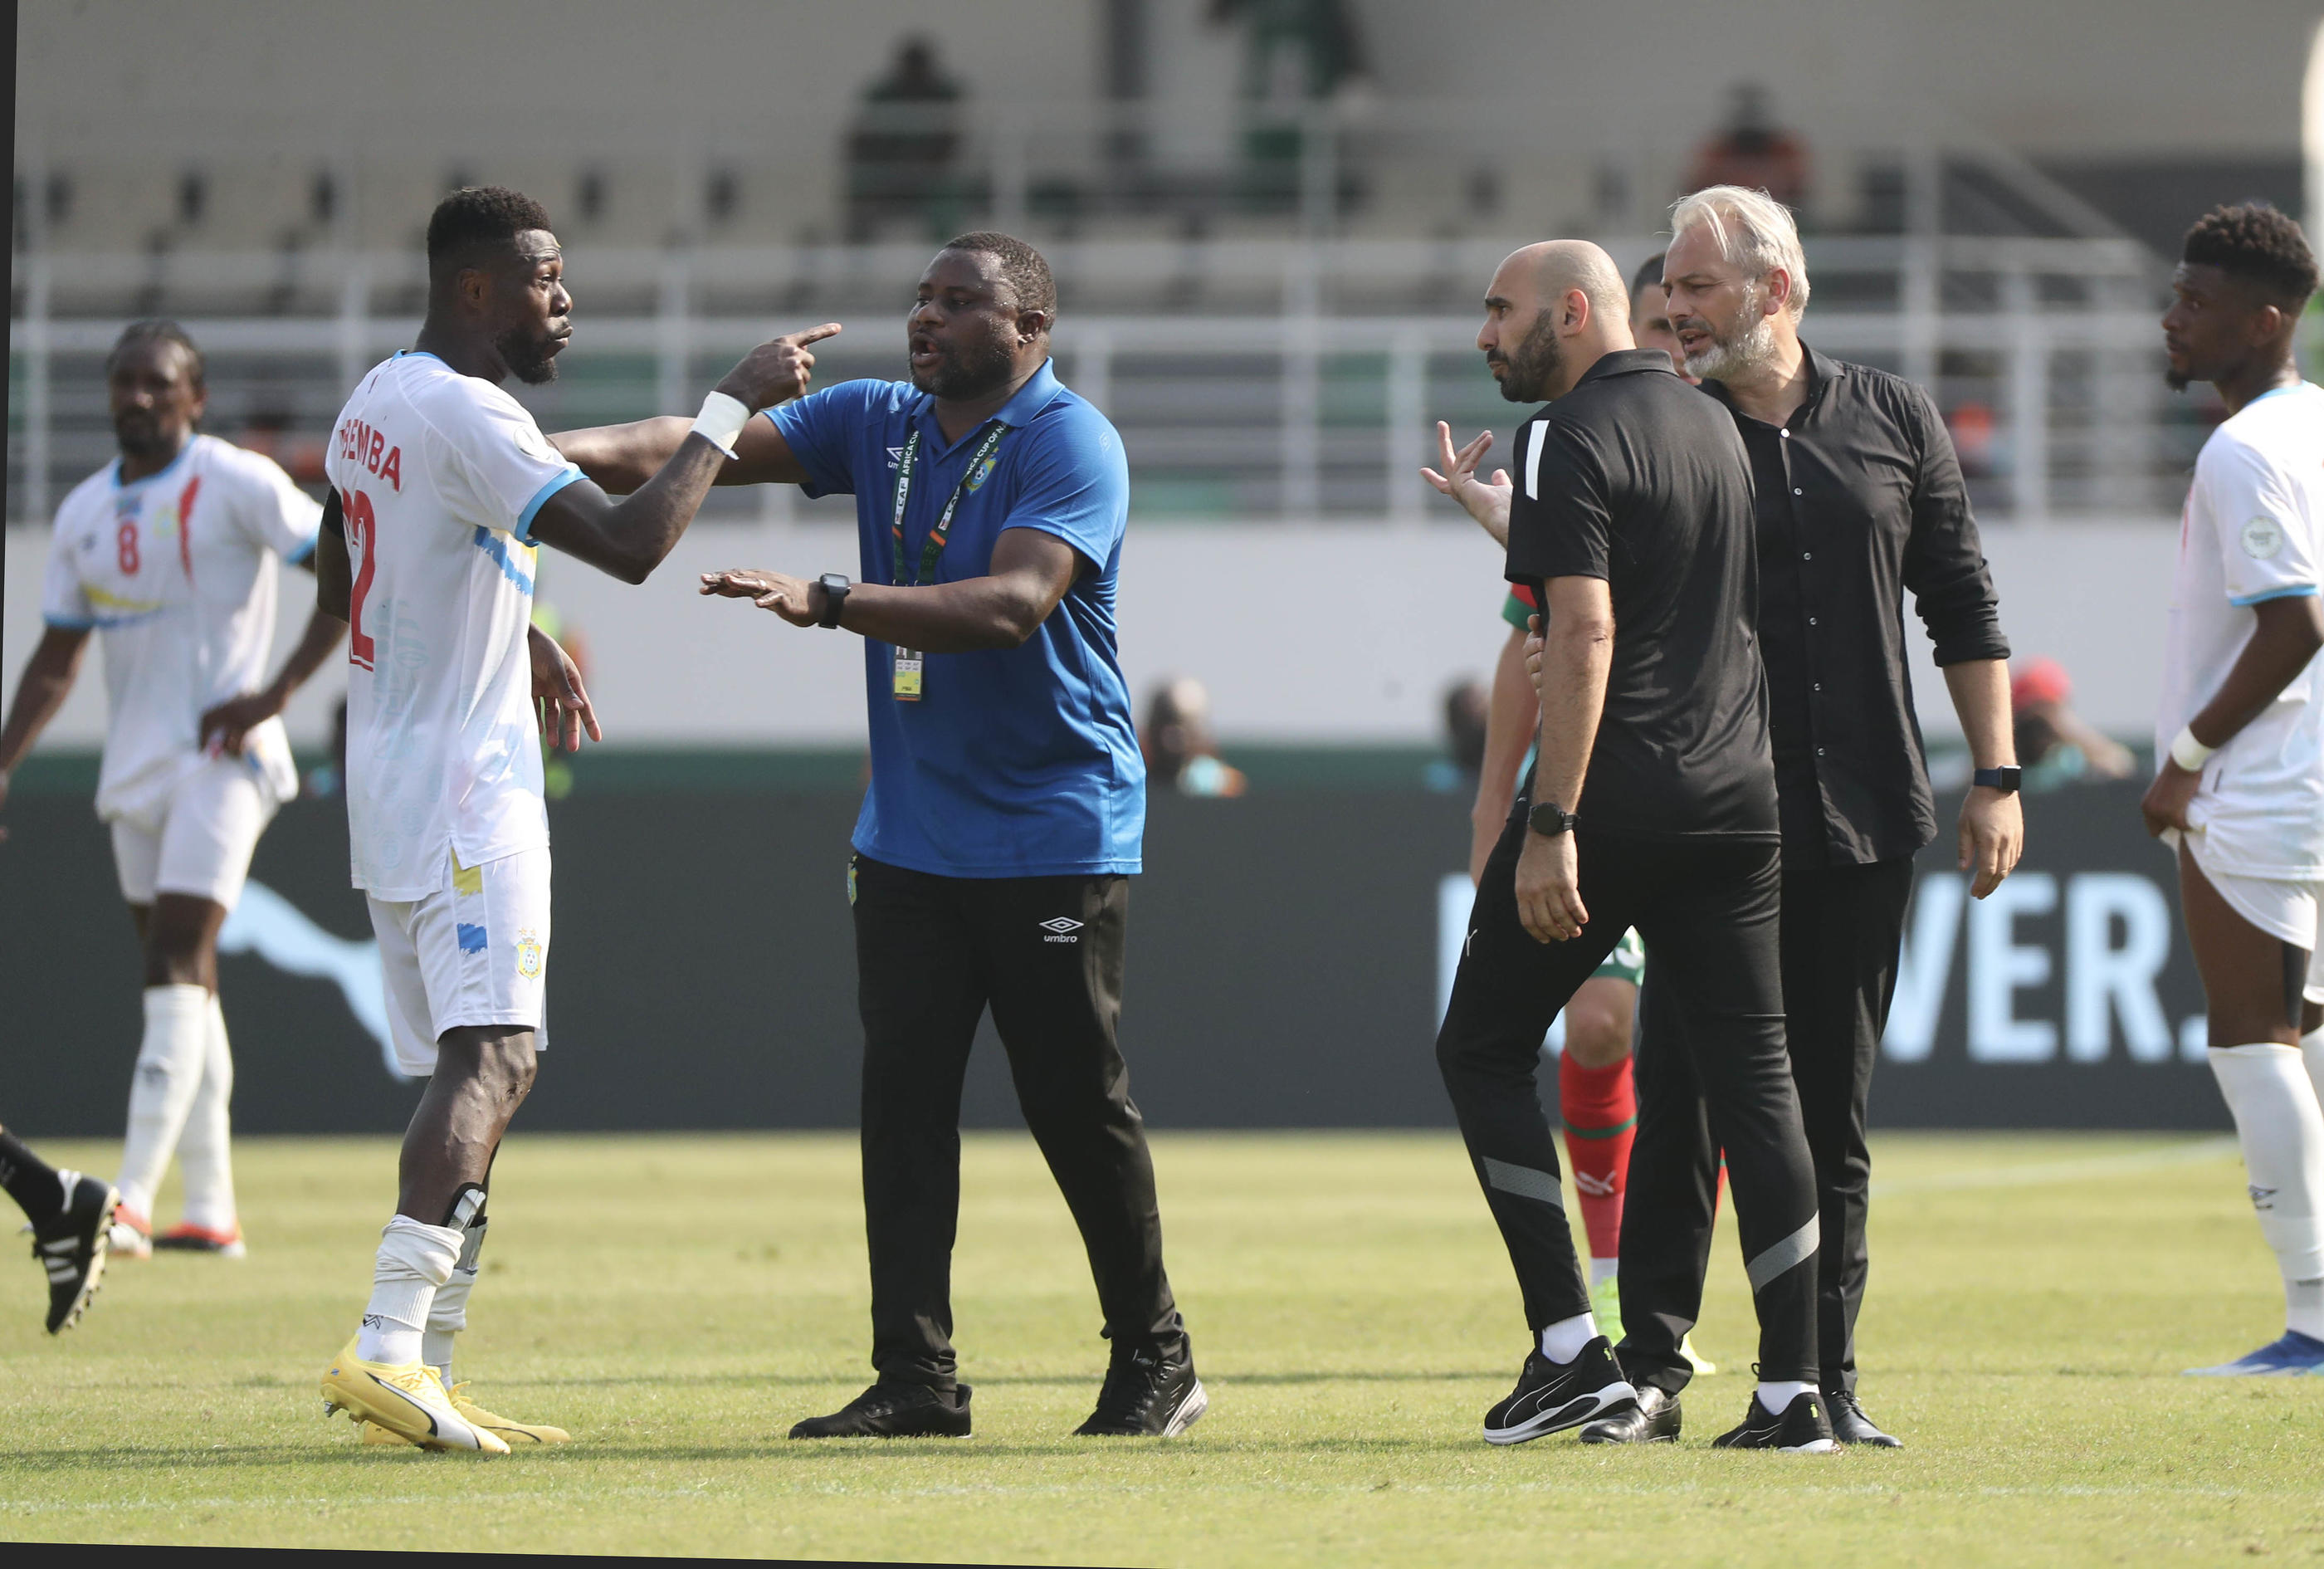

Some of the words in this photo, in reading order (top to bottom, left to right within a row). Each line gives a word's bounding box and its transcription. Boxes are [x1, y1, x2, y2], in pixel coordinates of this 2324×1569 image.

[977, 442, 989, 457] CUP
[988, 431, 998, 443] OF
[901, 444, 914, 475] AFRICA
[897, 482, 906, 506] CAF
[118, 521, 139, 577] 8
[1043, 934, 1078, 943] umbro
